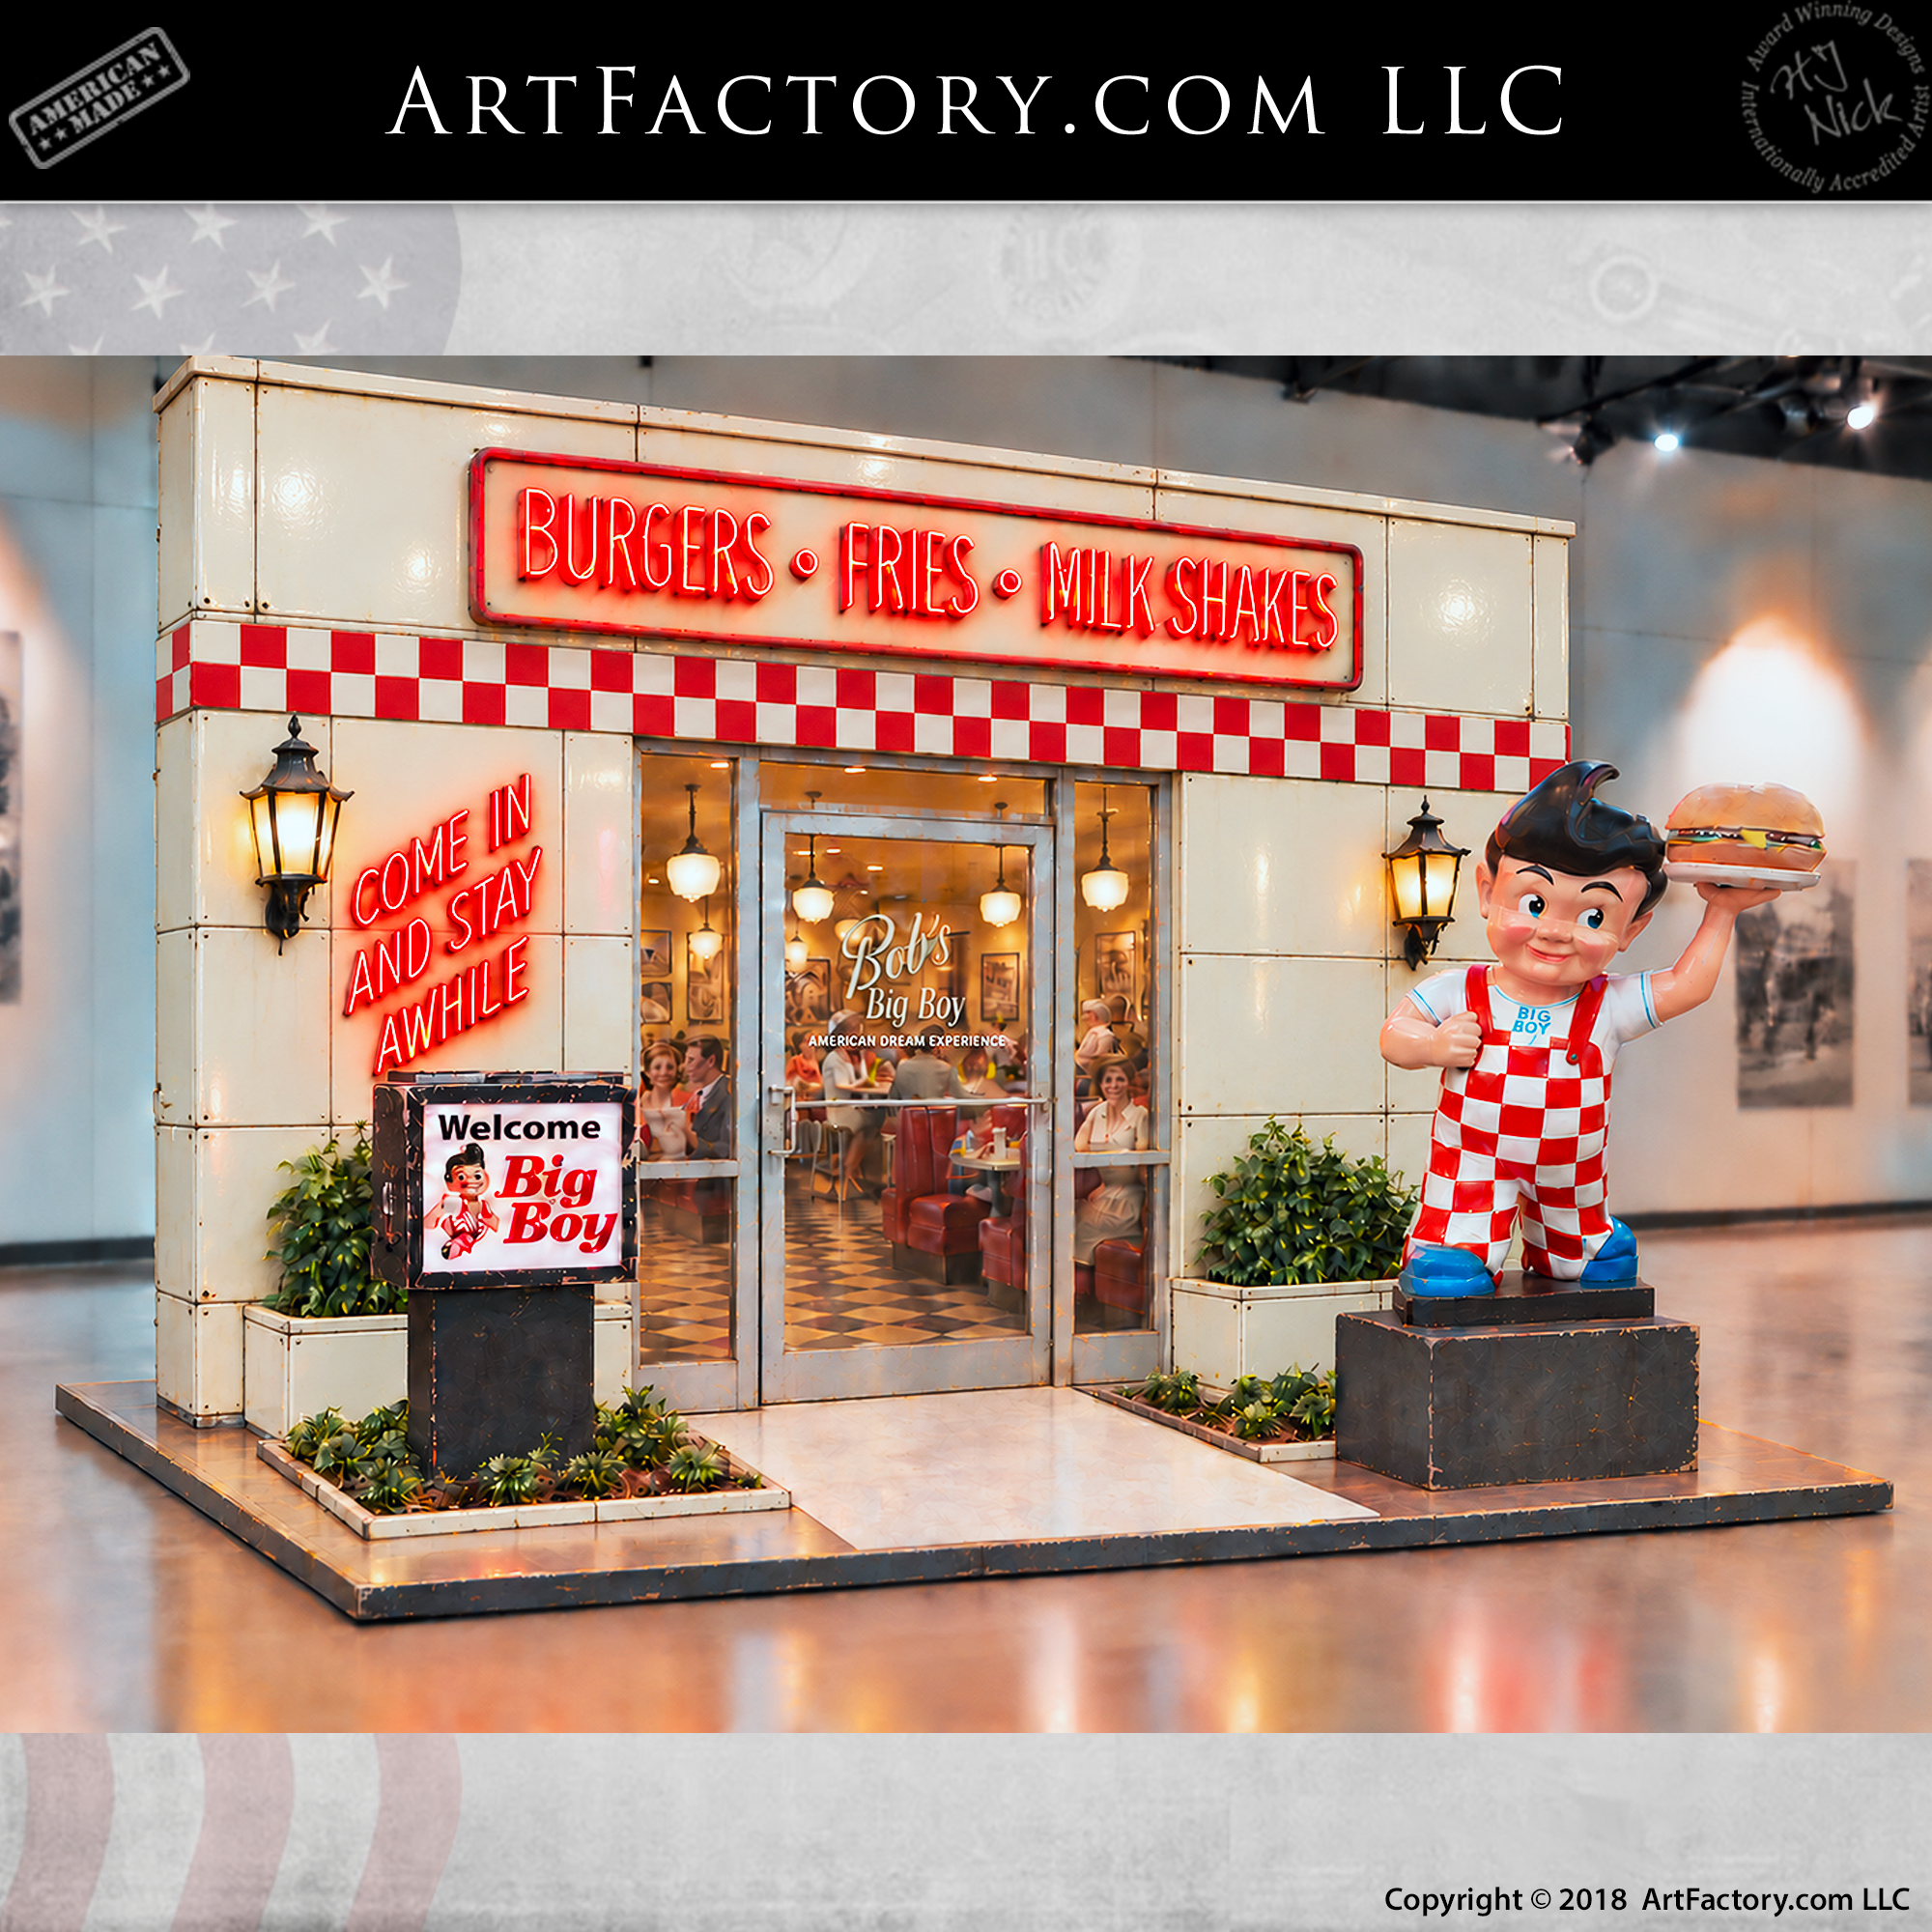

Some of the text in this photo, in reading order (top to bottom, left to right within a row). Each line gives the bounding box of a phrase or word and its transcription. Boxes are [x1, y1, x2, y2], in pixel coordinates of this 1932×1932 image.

[520, 486, 1340, 652] BURGERS FRIES MILK SHAKES
[352, 773, 530, 928] COME IN
[344, 846, 543, 1016] AND STAY
[842, 912, 952, 999] Bob's
[373, 935, 529, 1076] AWHILE
[866, 987, 966, 1028] Big Boy
[1512, 1019, 1551, 1036] BOY
[1518, 1006, 1551, 1022] BIG
[809, 1035, 1007, 1047] AMERICAN DREAM EXPERIENCE
[439, 1114, 601, 1141] Welcome
[495, 1154, 597, 1208] Big
[503, 1202, 618, 1254] Boy
